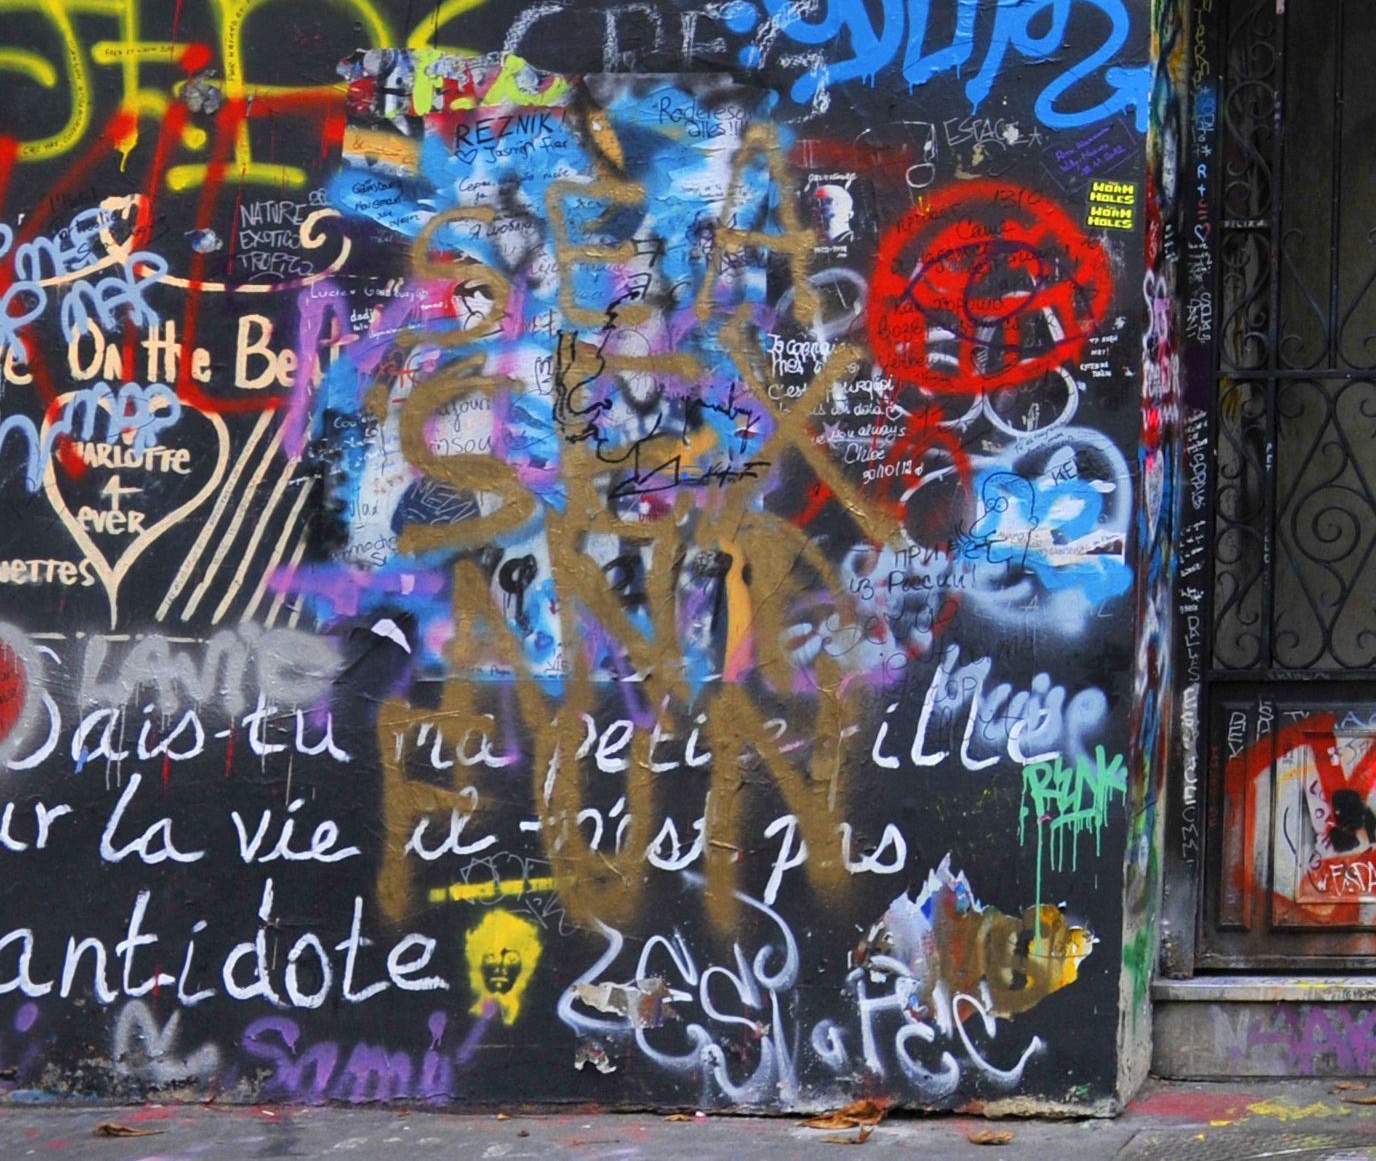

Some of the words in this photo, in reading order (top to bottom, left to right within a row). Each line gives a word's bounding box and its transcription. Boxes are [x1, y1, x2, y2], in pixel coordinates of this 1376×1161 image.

[100, 773, 205, 864] la
[230, 798, 362, 864] vie
[0, 879, 449, 1008] antidote
